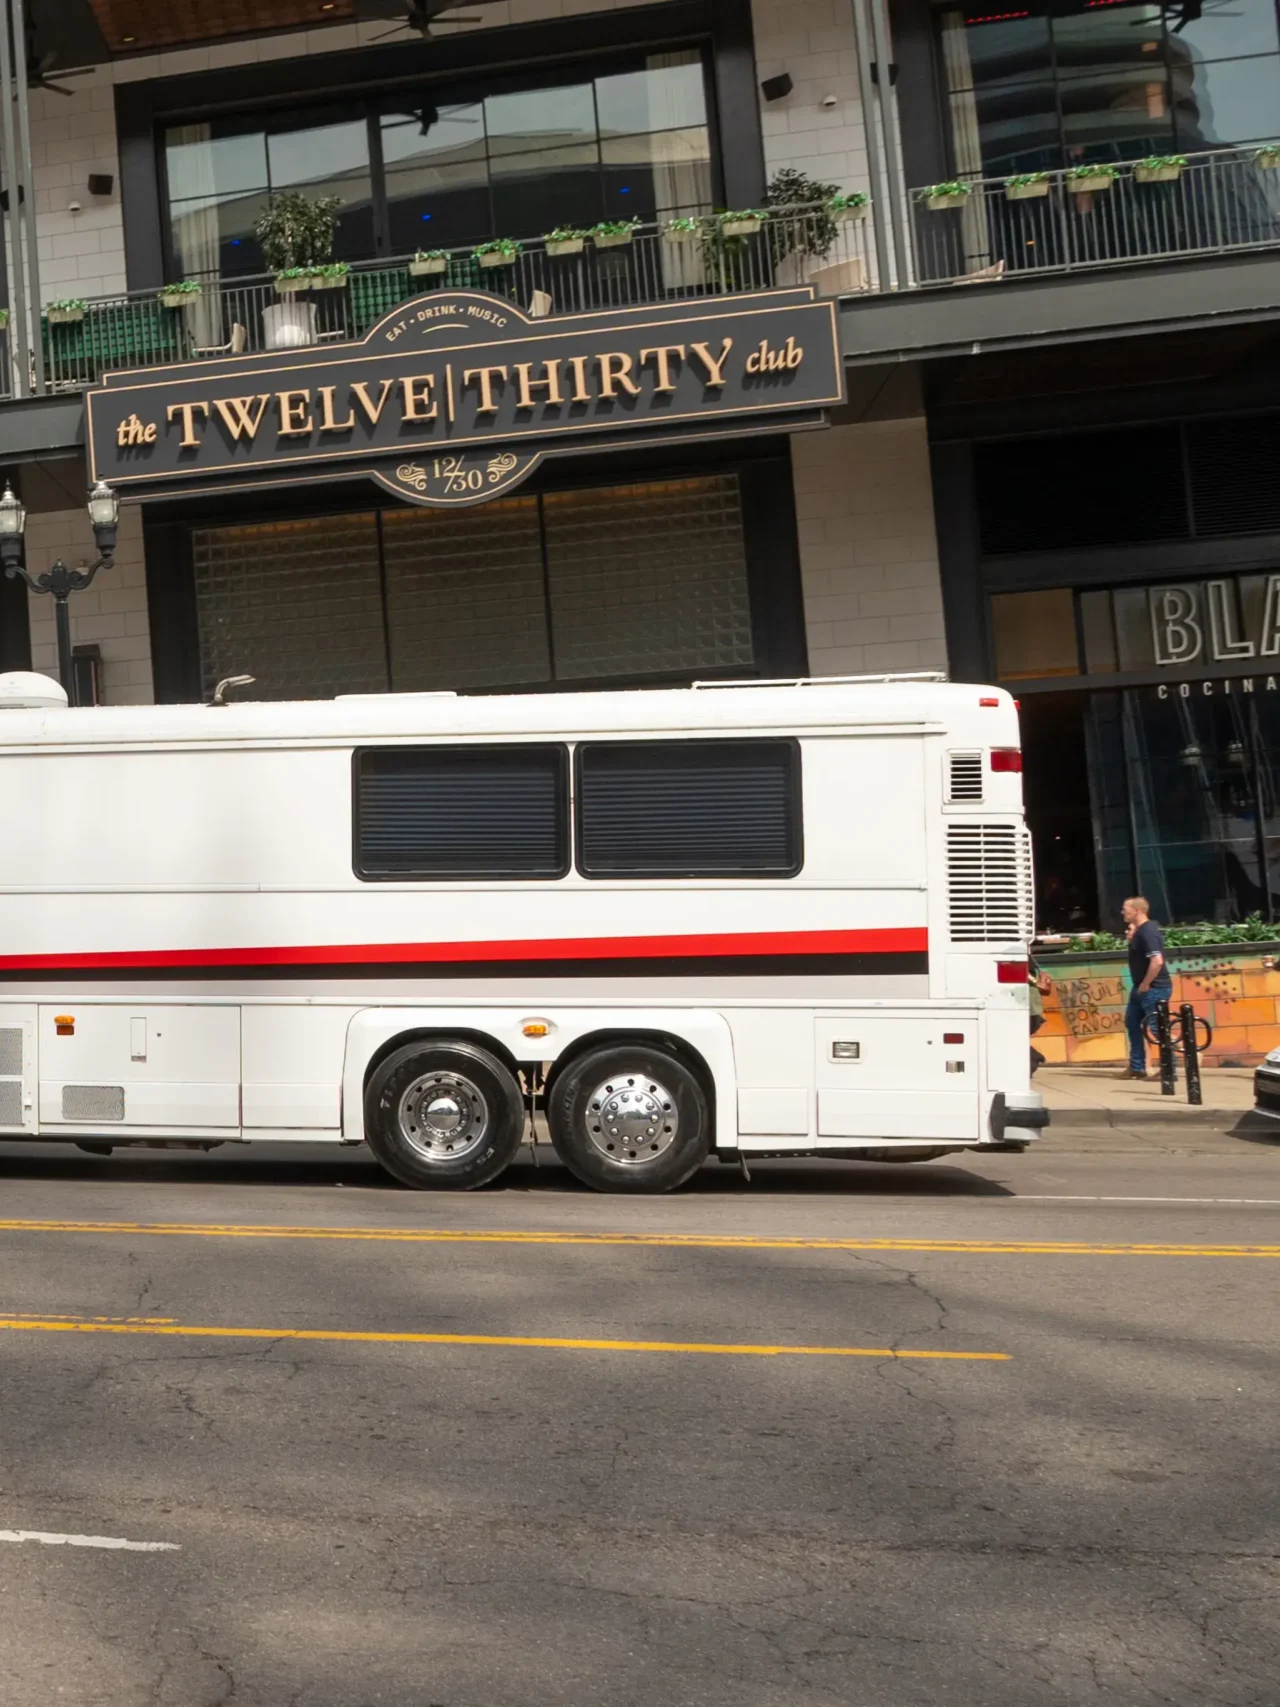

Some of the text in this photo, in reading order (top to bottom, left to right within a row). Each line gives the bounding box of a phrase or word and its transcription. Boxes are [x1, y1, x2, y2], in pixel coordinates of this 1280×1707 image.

[385, 304, 508, 342] EAT DRINK MUSIC
[116, 336, 804, 447] the TWELVE THIRTY club
[432, 454, 483, 494] 12/30
[1157, 676, 1277, 699] COCINA
